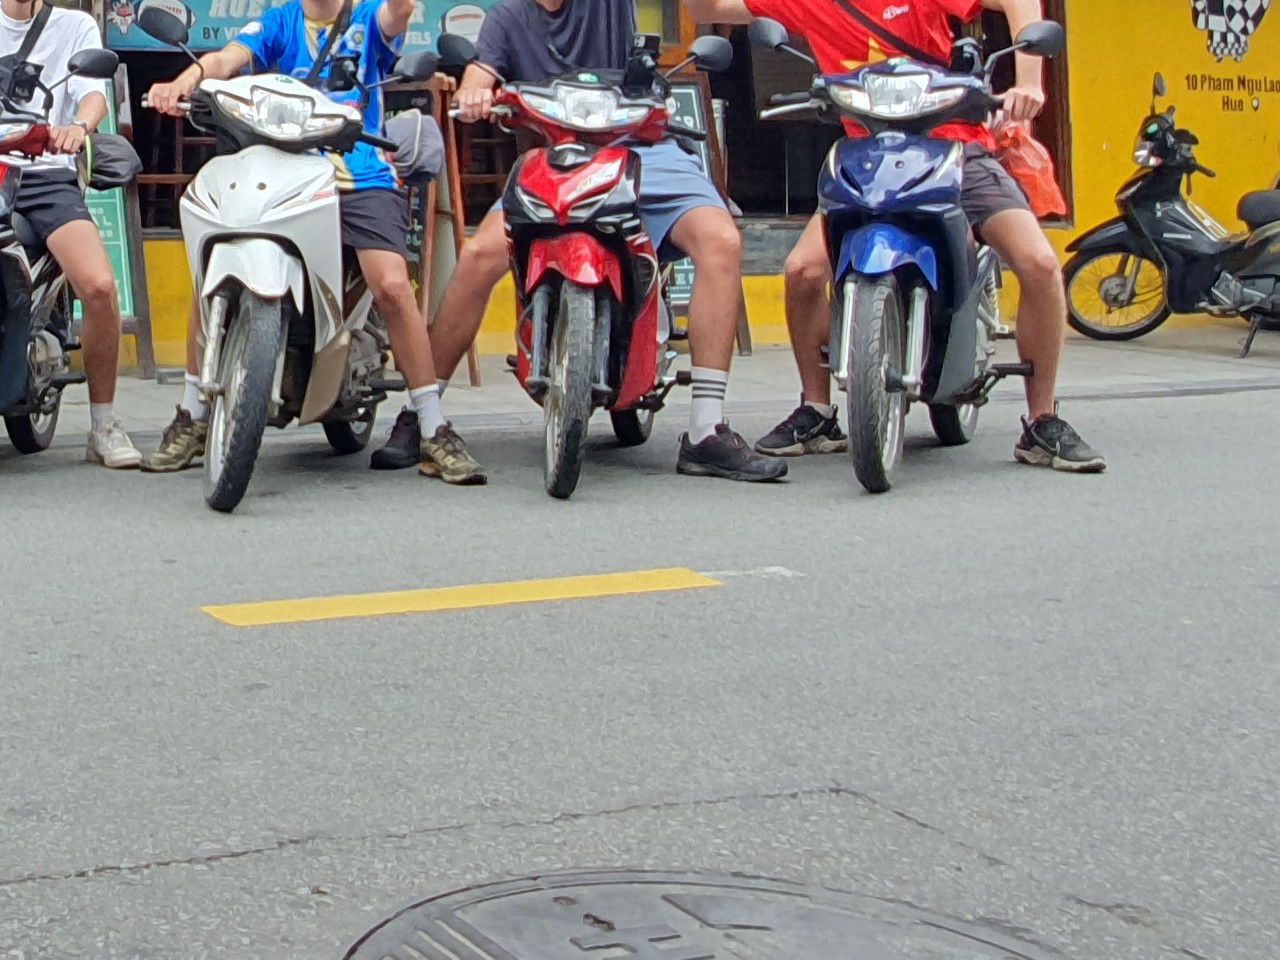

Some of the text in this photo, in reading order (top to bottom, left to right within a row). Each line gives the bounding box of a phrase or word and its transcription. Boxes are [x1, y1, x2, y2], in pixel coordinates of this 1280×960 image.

[202, 26, 221, 40] BY
[1185, 73, 1198, 91] 10
[1200, 74, 1234, 92] Pham
[1237, 75, 1262, 96] Ngu
[1222, 95, 1244, 112] Hue
